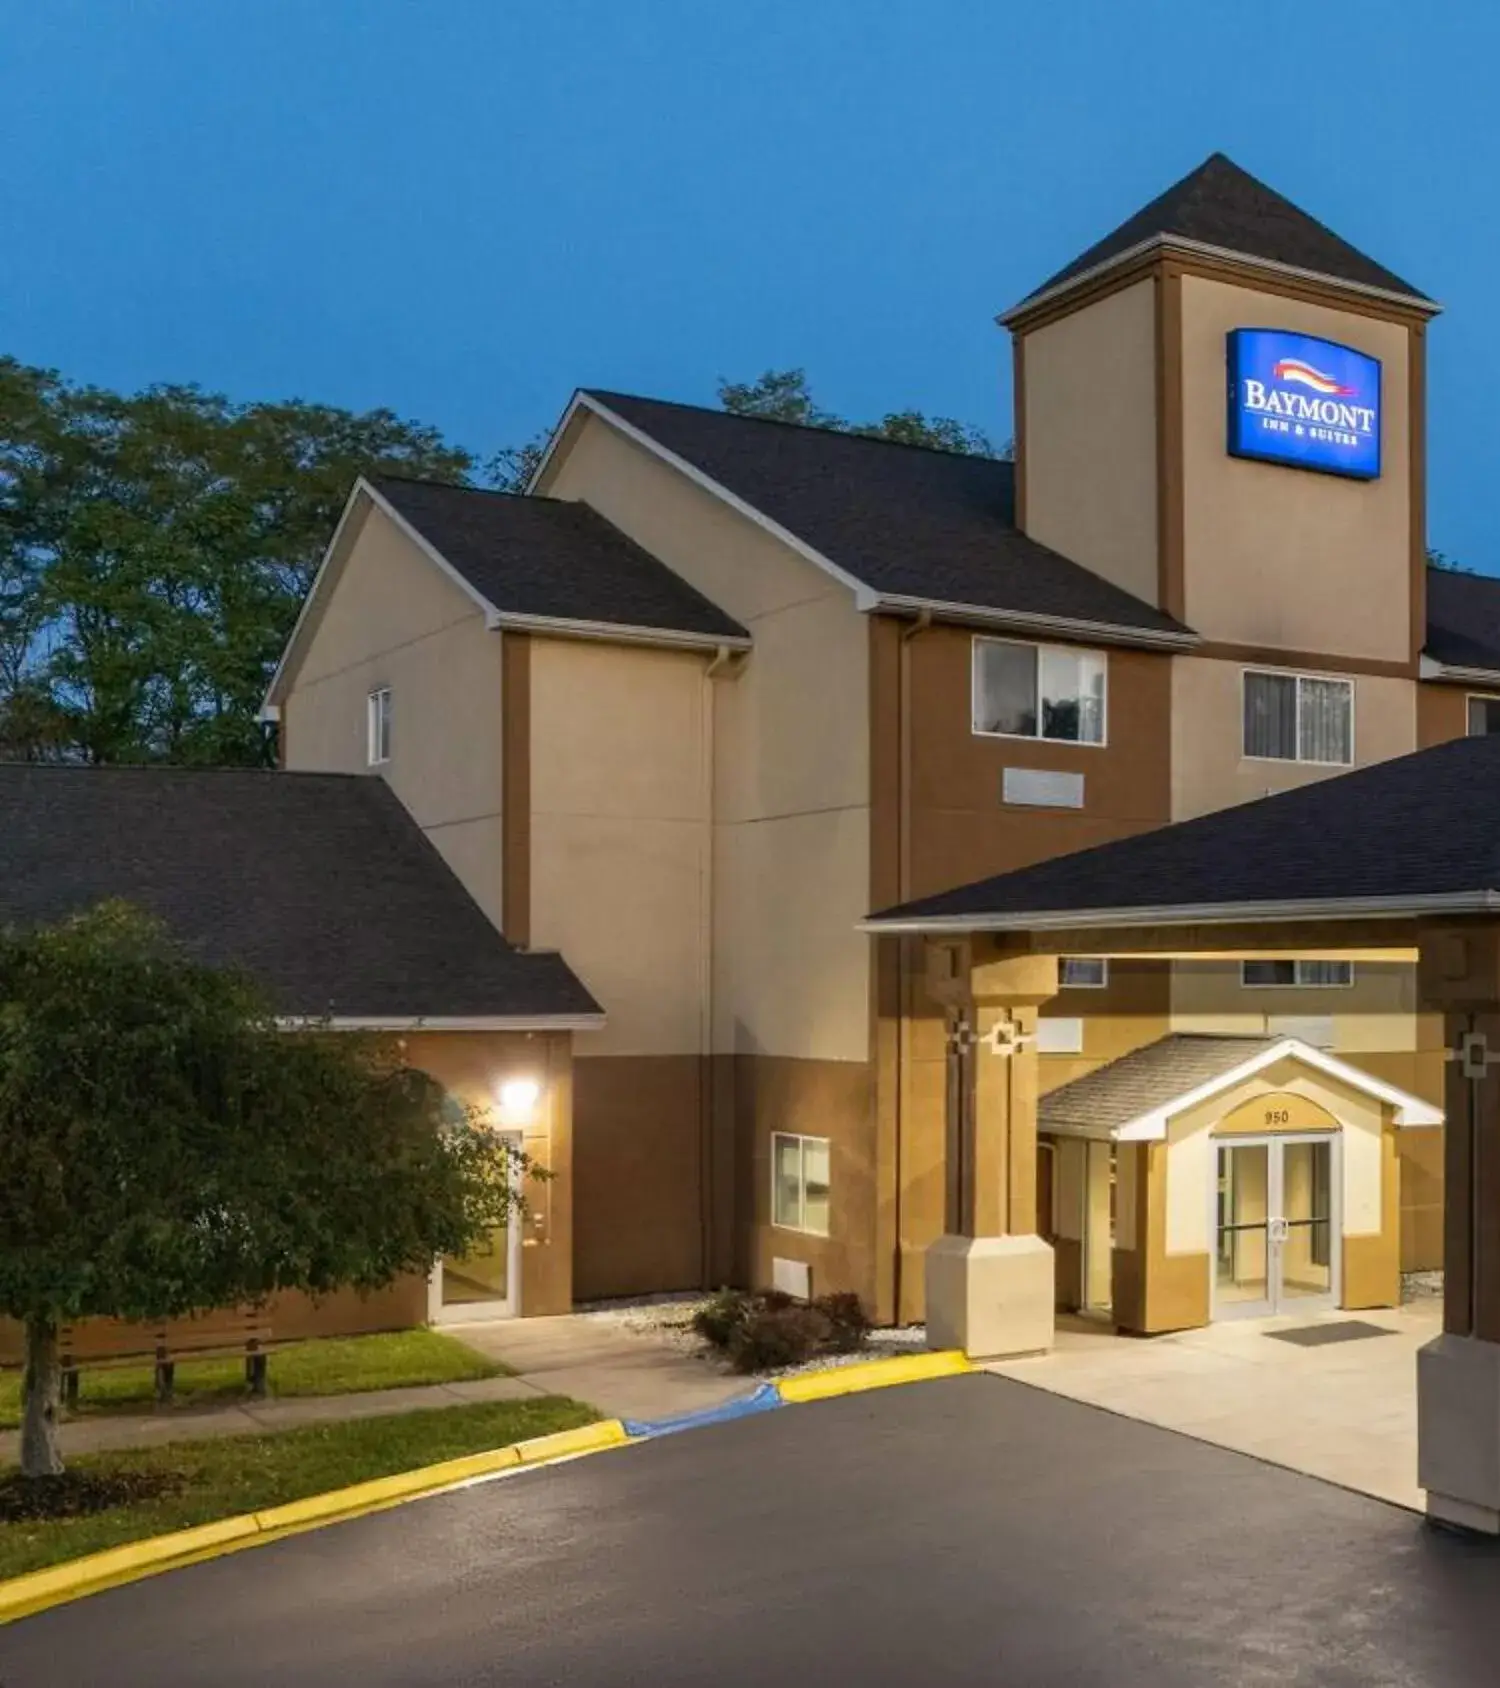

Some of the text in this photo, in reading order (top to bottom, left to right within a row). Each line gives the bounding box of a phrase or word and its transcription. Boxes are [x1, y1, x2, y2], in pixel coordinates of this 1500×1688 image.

[1244, 379, 1375, 432] BAYMONT
[1263, 418, 1358, 445] INN & SUITES
[1265, 1110, 1289, 1125] 950
